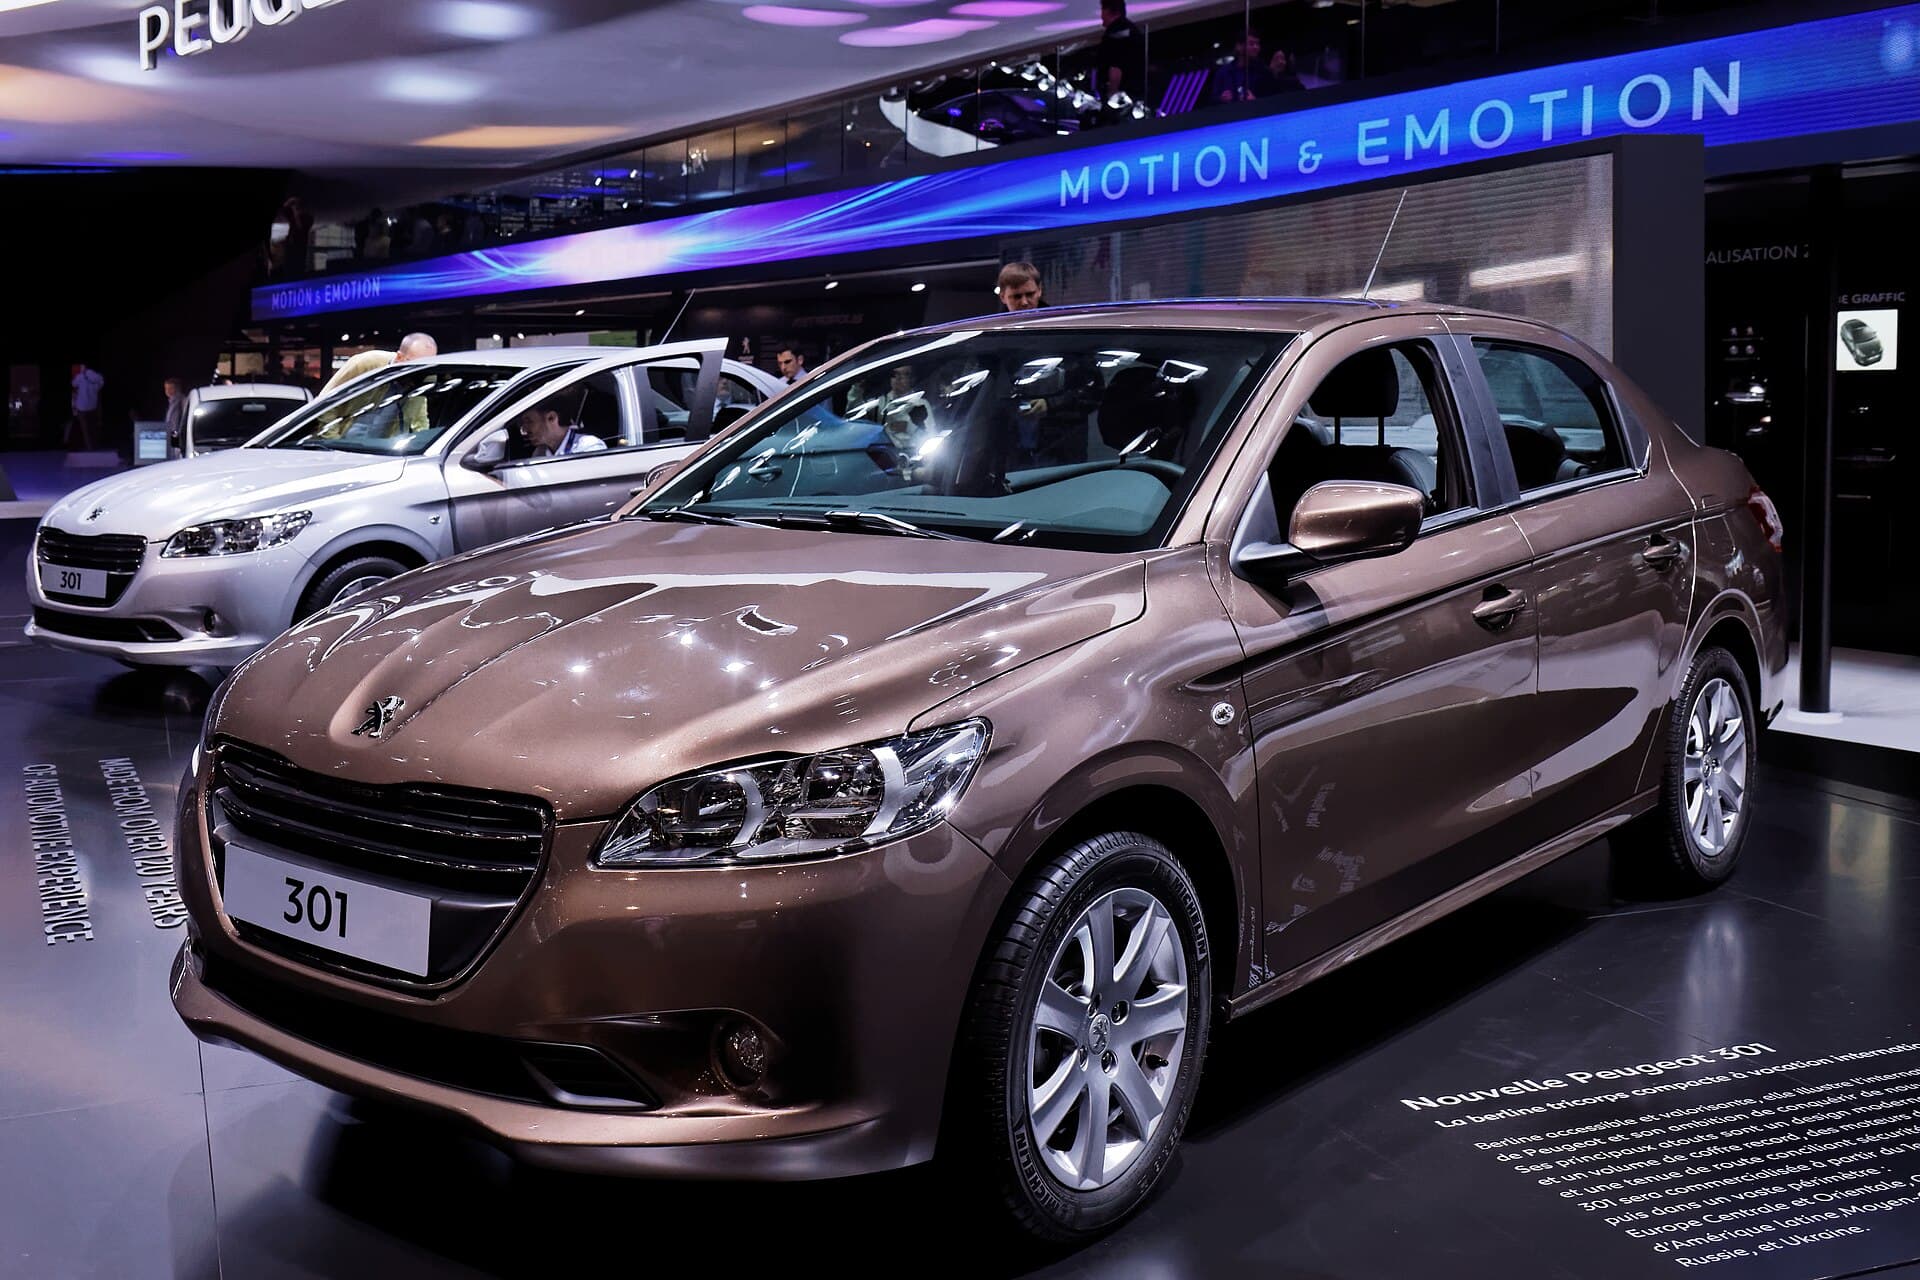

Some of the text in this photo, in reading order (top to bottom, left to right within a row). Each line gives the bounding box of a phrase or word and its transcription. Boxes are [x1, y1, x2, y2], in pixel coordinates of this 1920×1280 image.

[139, 0, 347, 71] PEU
[1060, 60, 1742, 207] MOTION & EMOTION
[271, 287, 312, 311] MOTION
[324, 276, 380, 304] EMOTION
[1851, 292, 1905, 304] GRAFFIC
[60, 571, 82, 590] 301
[23, 763, 94, 945] OF AUTOMOTIVE EXPERIENCE
[98, 757, 189, 929] MADE FROM OVER 120 YEARS
[283, 877, 349, 938] 301
[1170, 876, 1208, 961] MICHELIN
[1400, 1042, 1777, 1111] Nouvelle Peugeot 301
[1435, 1117, 1467, 1128] La
[1466, 1104, 1547, 1124] berline
[1546, 1091, 1630, 1111] tricorps
[1631, 1073, 1732, 1096] compacte
[1729, 1071, 1749, 1080] à
[1747, 1056, 1834, 1077] vocation
[1474, 1133, 1544, 1150] Berline
[1545, 1117, 1638, 1139] accessible
[1639, 1114, 1661, 1122] et
[1762, 1089, 1798, 1103] elle
[1795, 1080, 1855, 1096] illustre
[1496, 1151, 1523, 1162] de
[1522, 1137, 1607, 1156] Peugeot
[1607, 1133, 1630, 1143] et
[1630, 1128, 1667, 1138] son
[1668, 1113, 1749, 1132] ambition
[1750, 1107, 1775, 1117] de
[1776, 1093, 1858, 1114] conquérir
[1860, 1090, 1884, 1098] de
[1514, 1096, 1920, 1174] Ses principaux atouts sont un design modern
[1538, 1176, 1561, 1186] et
[1561, 1171, 1588, 1182] un
[1588, 1159, 1662, 1175] volume
[1662, 1154, 1688, 1163] de
[1689, 1145, 1743, 1159] coffre
[1806, 1126, 1840, 1138] des
[1839, 1113, 1912, 1132] moteurs
[1559, 1188, 1583, 1198] et
[1583, 1181, 1624, 1194] une
[1623, 1170, 1684, 1186] tenue
[1685, 1166, 1711, 1175] de
[1712, 1156, 1764, 1171] route
[1766, 1138, 1857, 1161] conciliant
[1577, 1198, 1618, 1211] 301
[1618, 1190, 1663, 1205] sera
[1665, 1164, 1811, 1196] commercialisée
[1810, 1159, 1828, 1168] à
[1826, 1150, 1878, 1167] partir
[1880, 1147, 1905, 1155] du
[1605, 1211, 1649, 1227] puis
[1651, 1201, 1702, 1216] dans
[1702, 1196, 1732, 1206] un
[1731, 1184, 1788, 1201] vaste
[1787, 1167, 1881, 1192] périmètre
[1625, 1219, 1703, 1238] Europe
[1702, 1202, 1790, 1223] Centrale
[1791, 1197, 1816, 1207] et
[1654, 1223, 1776, 1253] d'Amérique
[1758, 1240, 1783, 1251] et
[1779, 1224, 1871, 1248] Ukraine.
